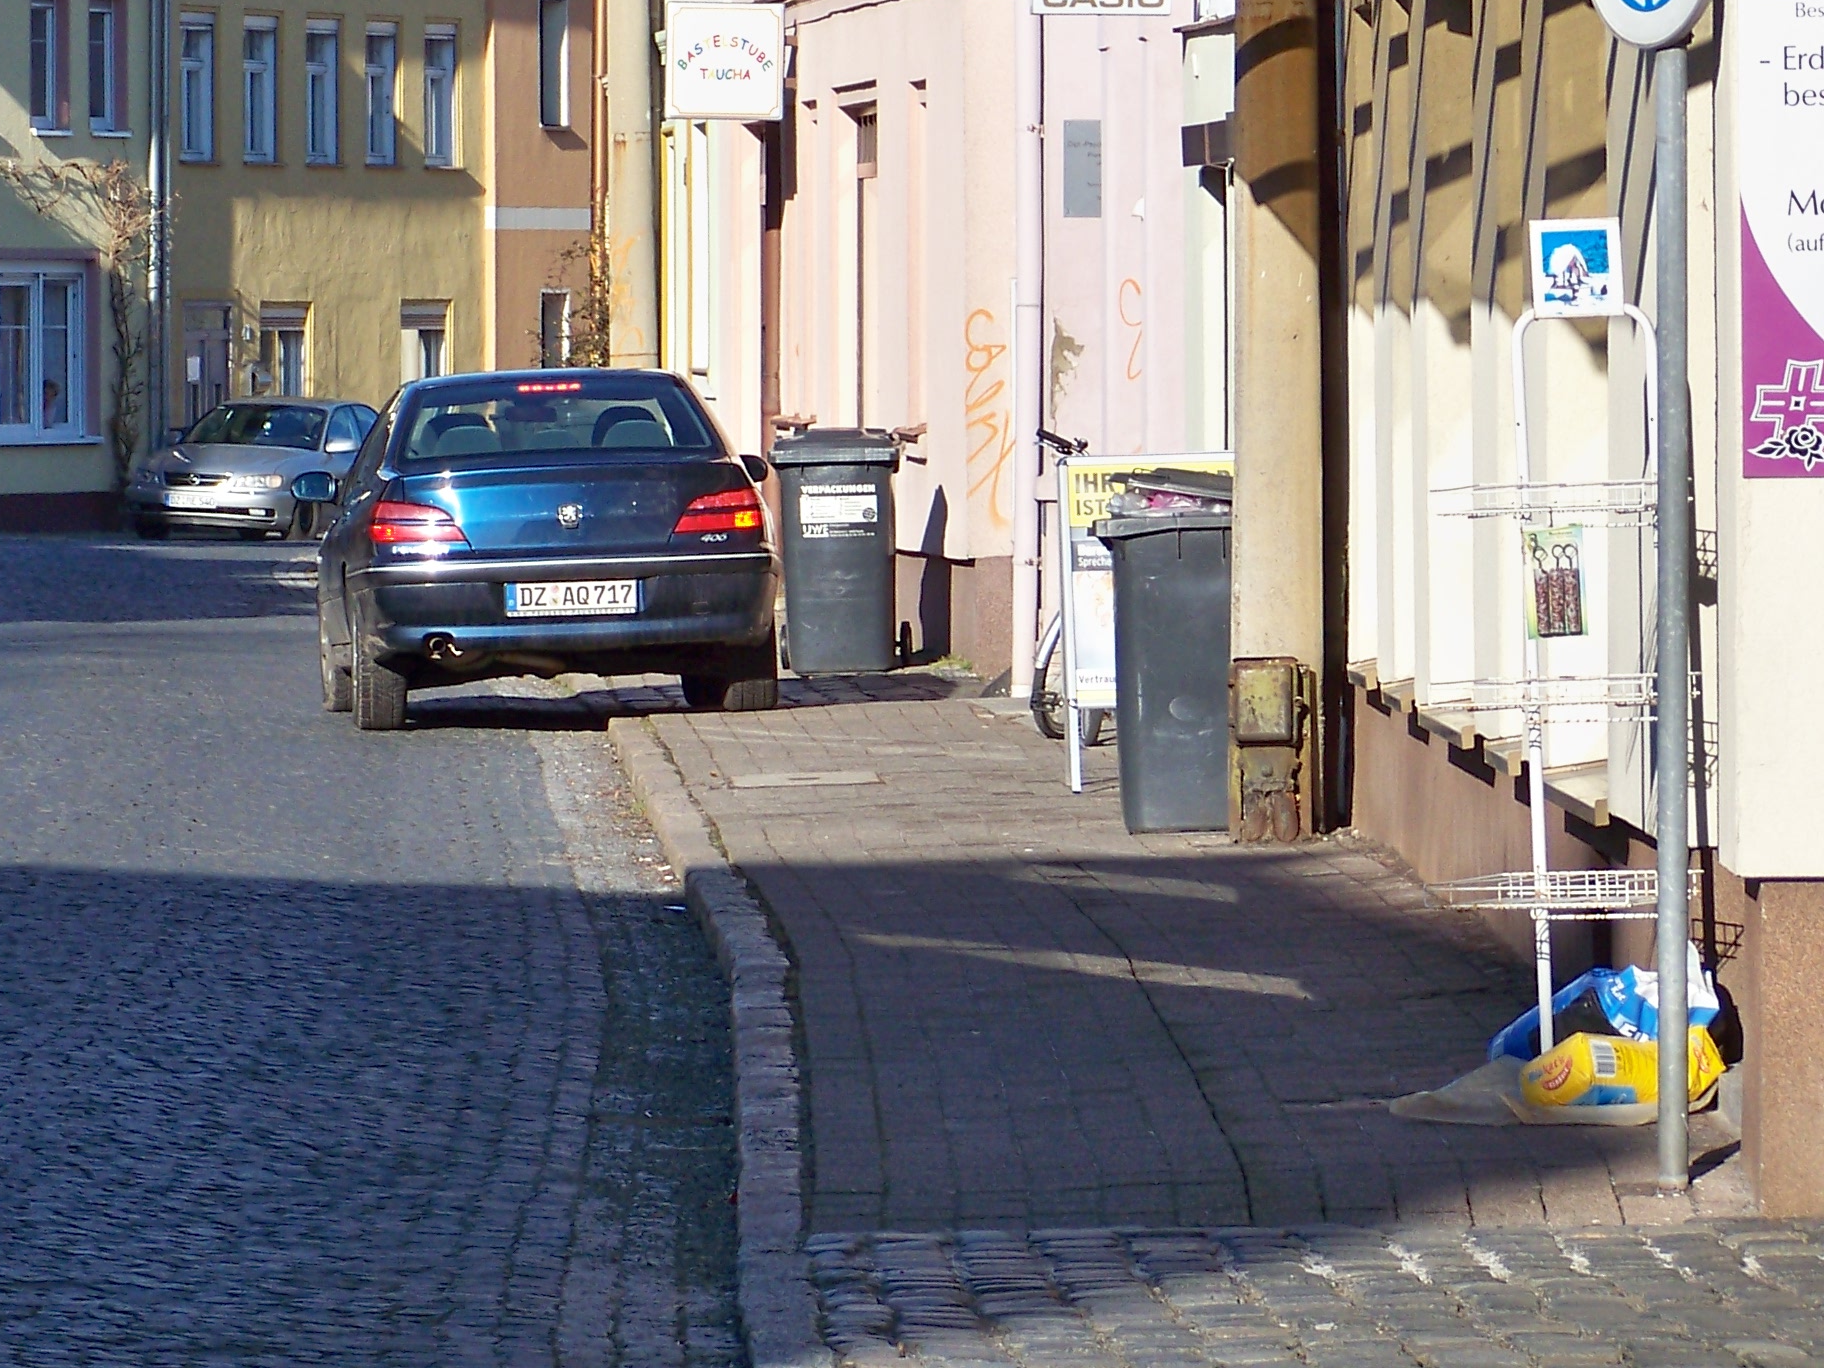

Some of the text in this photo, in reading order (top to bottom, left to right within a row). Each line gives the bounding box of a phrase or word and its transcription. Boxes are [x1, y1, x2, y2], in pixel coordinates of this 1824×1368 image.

[677, 34, 774, 72] BASTELSTUBE
[700, 67, 751, 80] TAUCHA
[800, 484, 876, 494] VERPACKUNGEN
[520, 586, 547, 607] DZ
[562, 585, 590, 606] AQ
[594, 584, 633, 605] 717
